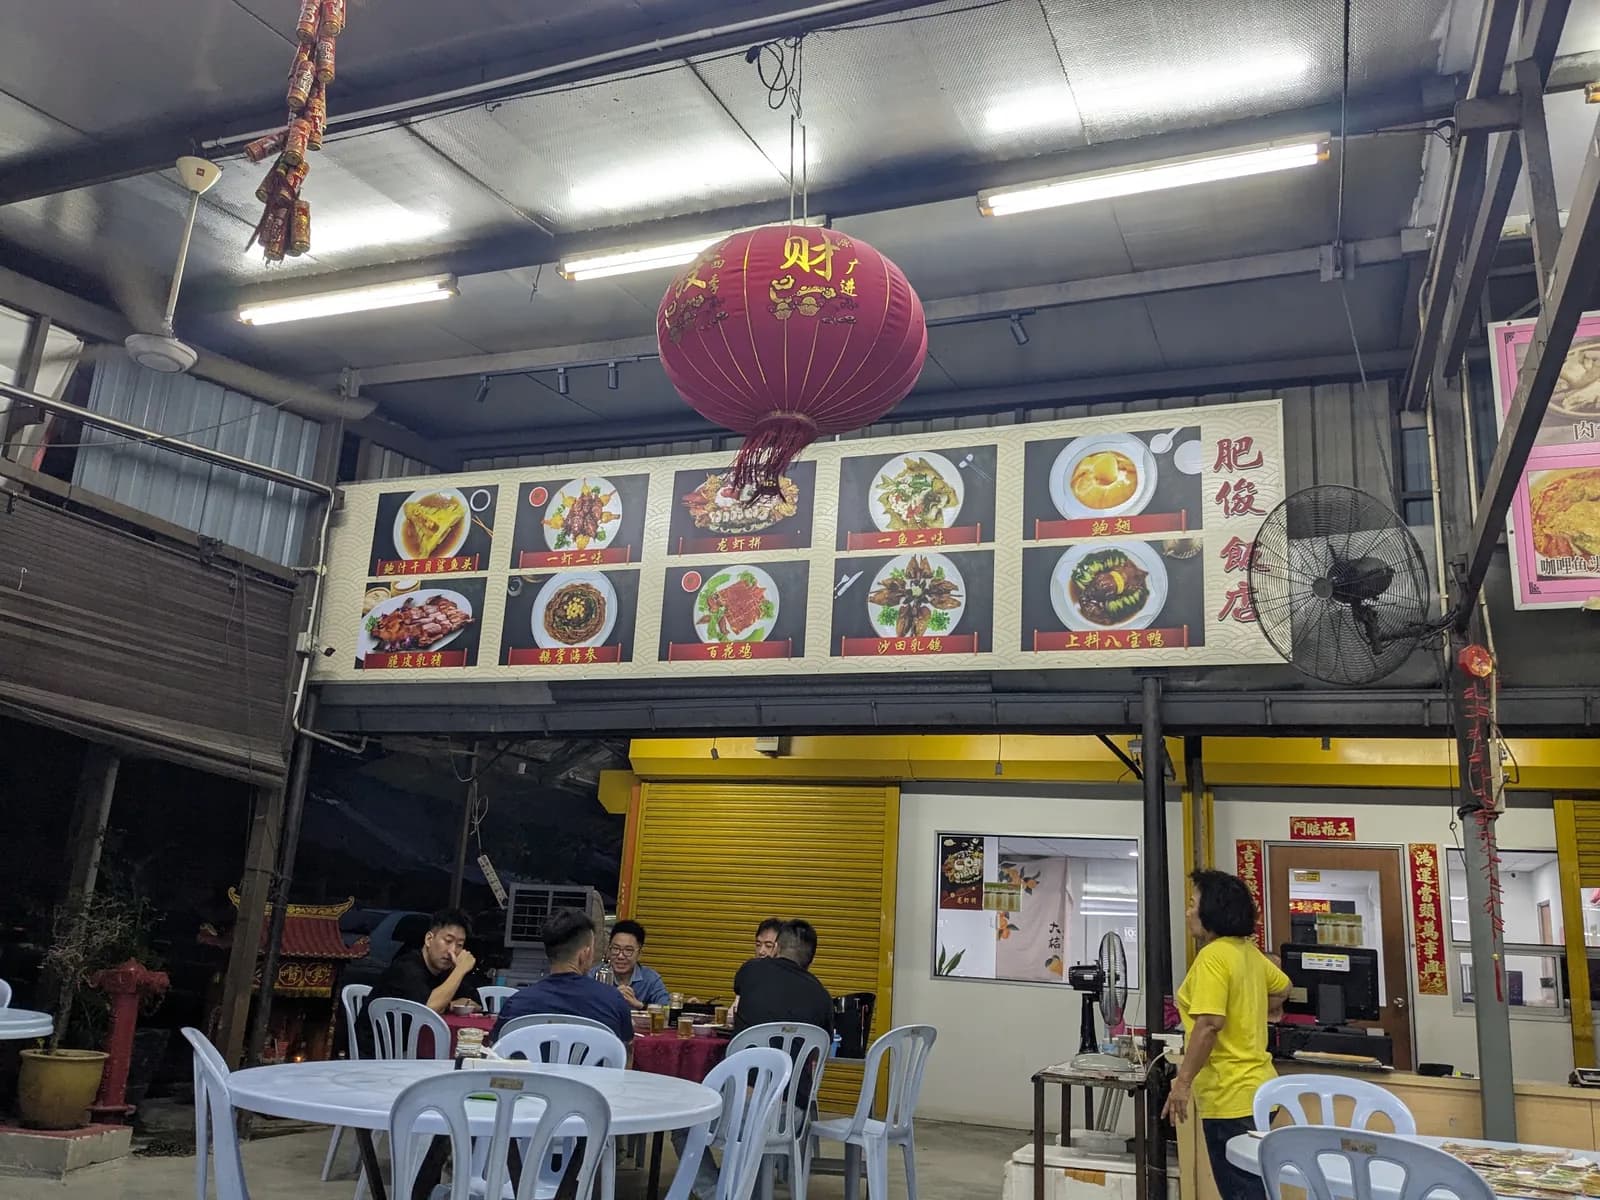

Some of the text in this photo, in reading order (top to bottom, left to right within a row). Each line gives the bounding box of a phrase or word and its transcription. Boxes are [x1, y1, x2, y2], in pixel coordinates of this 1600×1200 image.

[1573, 420, 1600, 441] 肉
[716, 537, 762, 552] 龙虾拼
